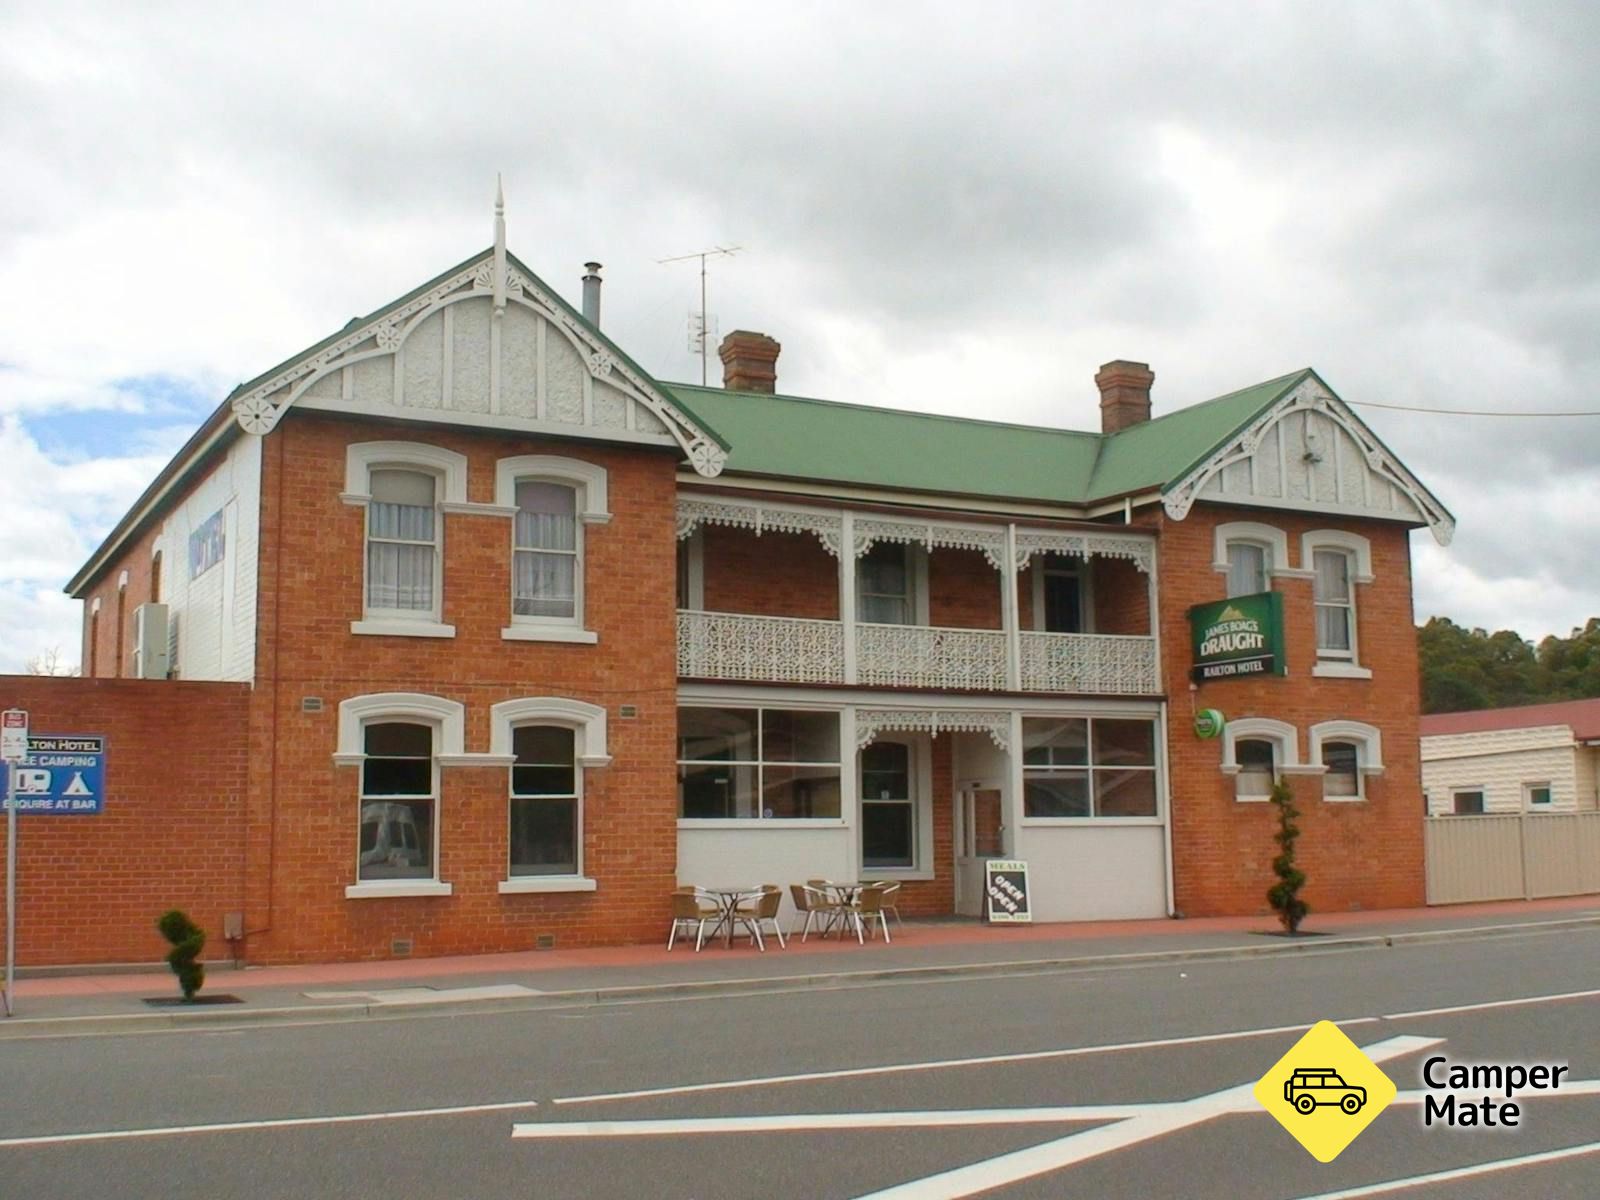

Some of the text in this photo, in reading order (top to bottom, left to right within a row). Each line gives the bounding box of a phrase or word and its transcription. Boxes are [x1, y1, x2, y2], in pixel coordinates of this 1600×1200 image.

[1205, 621, 1229, 640] JAMES
[1200, 632, 1264, 657] DRAUGHT
[1203, 660, 1264, 678] RAILTON HOTEL
[27, 741, 57, 750] LTON
[59, 740, 99, 751] HOTEL
[40, 756, 97, 767] CAMPING
[3, 799, 97, 809] EQUIRE AT BAR
[990, 862, 1026, 870] MEALS
[994, 875, 1025, 901] OPEN
[989, 886, 1018, 912] OPEN
